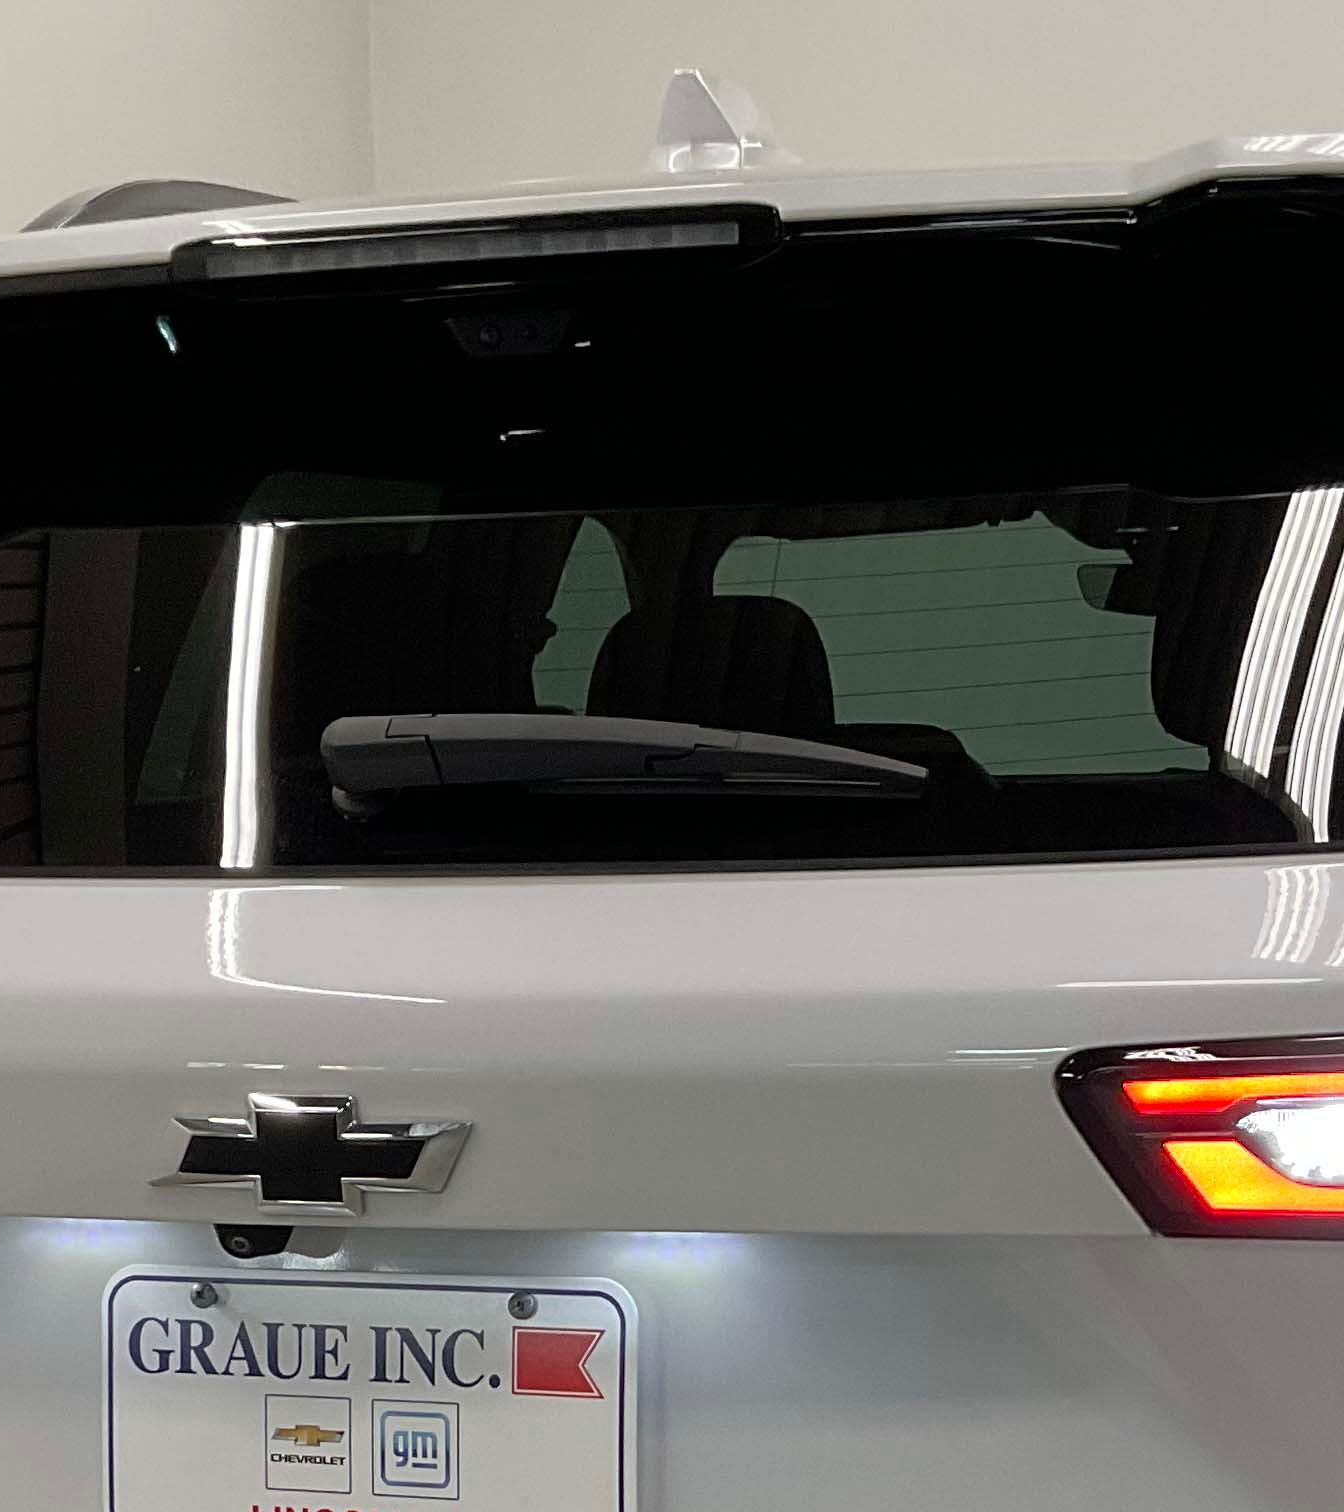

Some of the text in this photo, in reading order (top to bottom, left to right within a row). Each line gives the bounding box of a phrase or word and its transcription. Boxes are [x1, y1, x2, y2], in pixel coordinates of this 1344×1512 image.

[128, 1316, 501, 1389] GRAUE INC.
[270, 1452, 346, 1467] CHEVROLET
[392, 1430, 438, 1469] gm
